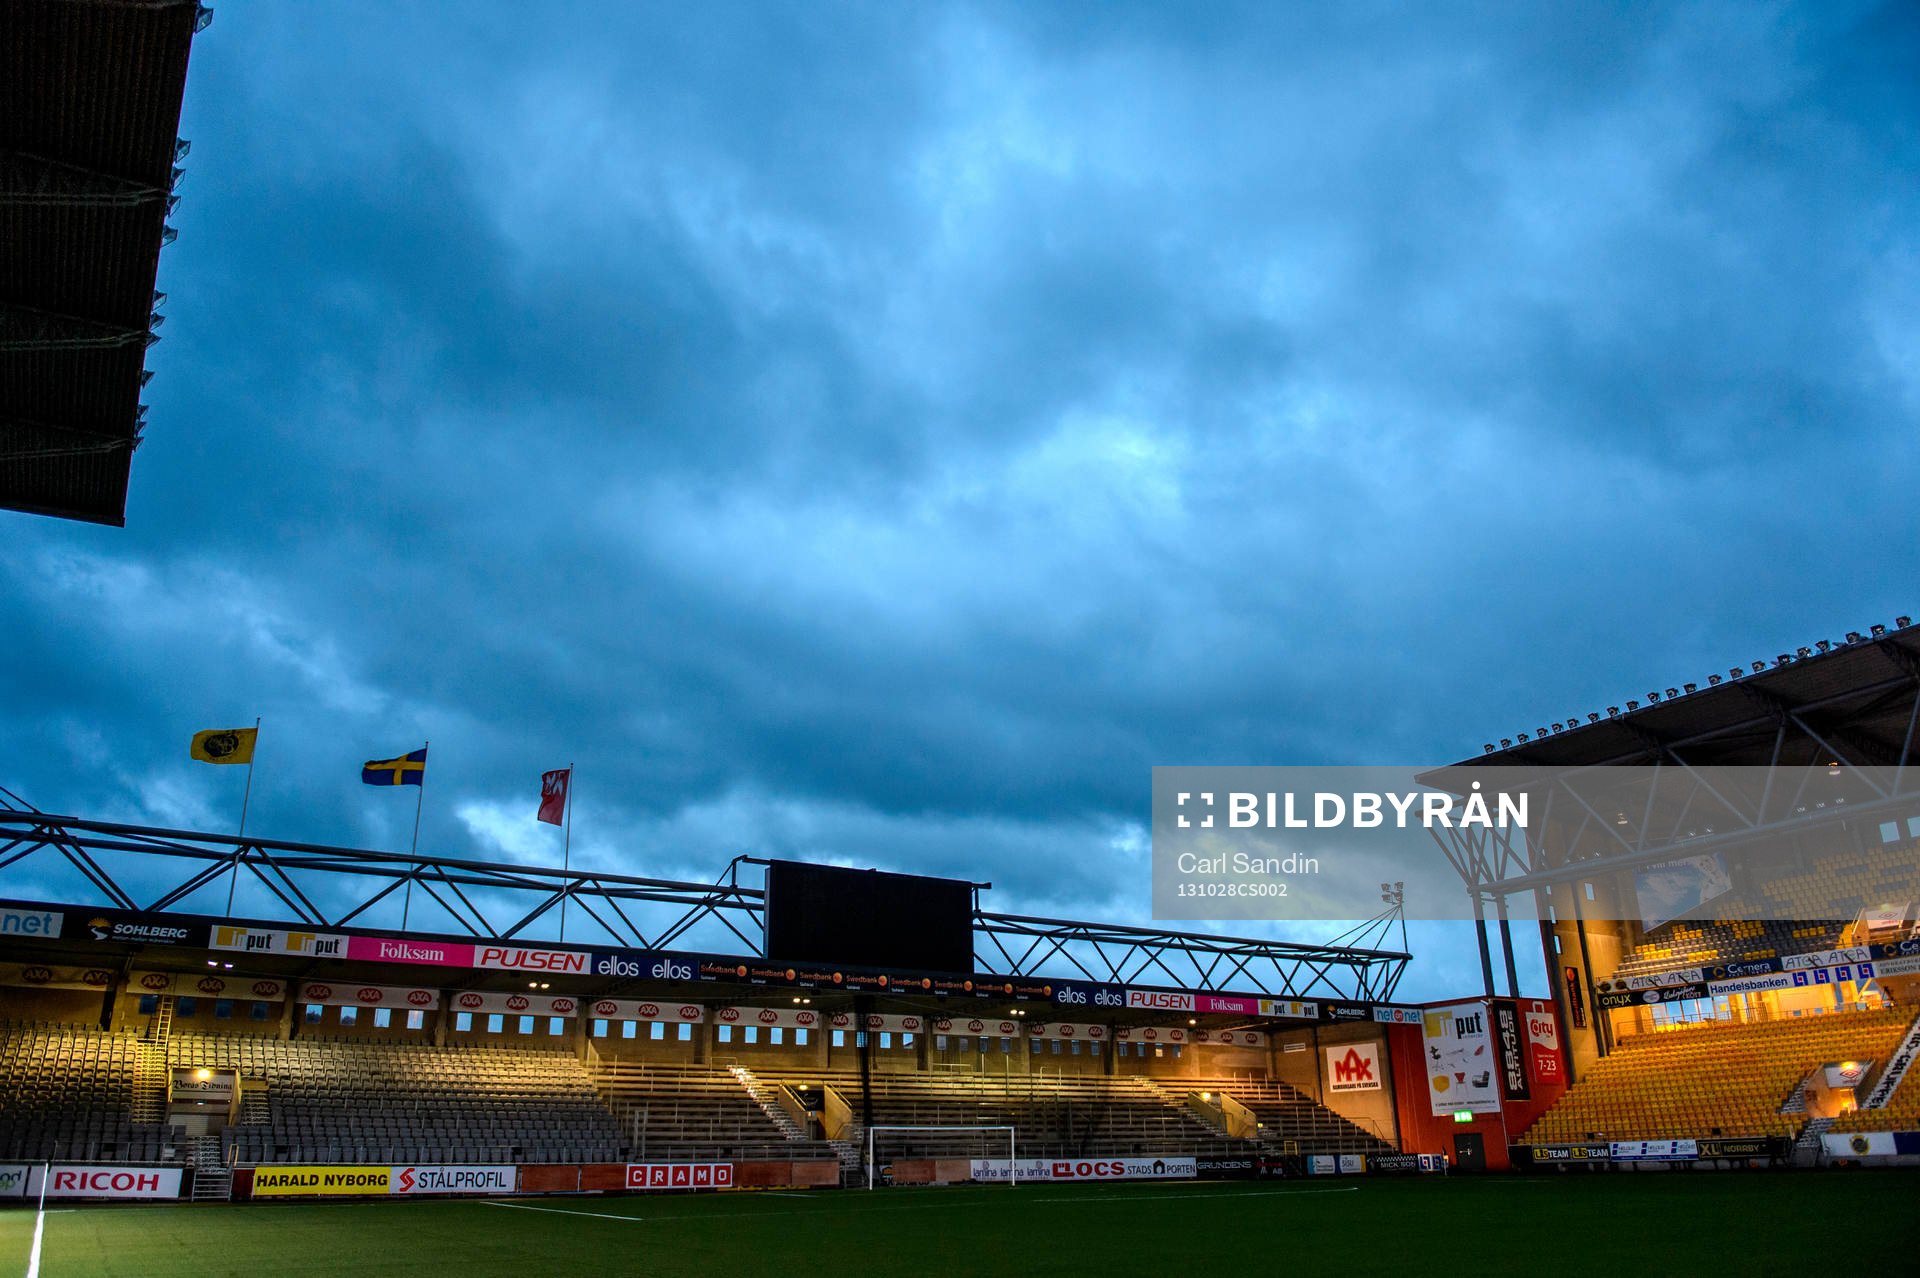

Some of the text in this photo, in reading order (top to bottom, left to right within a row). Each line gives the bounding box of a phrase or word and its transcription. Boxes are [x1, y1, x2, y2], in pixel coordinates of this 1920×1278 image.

[112, 923, 188, 938] SOHLBERG
[379, 941, 444, 961] Folksam
[480, 948, 585, 971] PULSEN
[598, 955, 639, 976] ellos
[652, 959, 692, 980] ellos
[800, 973, 832, 982] Swedbank
[846, 975, 878, 984] Swedbank
[1710, 978, 1788, 993] Handelsbanken
[1058, 986, 1086, 1004] ellos
[1095, 988, 1122, 1006] ellos
[1130, 992, 1190, 1009] PULSEN
[1602, 994, 1631, 1006] onyx
[1209, 998, 1244, 1012] Folksam
[1500, 1009, 1518, 1091] 8848
[1507, 1010, 1523, 1091] ALTITUDE
[1335, 1048, 1373, 1082] MAX
[418, 1167, 507, 1189] STÅLPROFIL
[632, 1169, 727, 1183] CRAMO
[973, 1168, 997, 1177] lamina
[1000, 1168, 1024, 1177] lamna
[1027, 1167, 1050, 1176] lamina
[54, 1172, 160, 1191] RICOH
[256, 1174, 388, 1187] HARALD NYBORG
